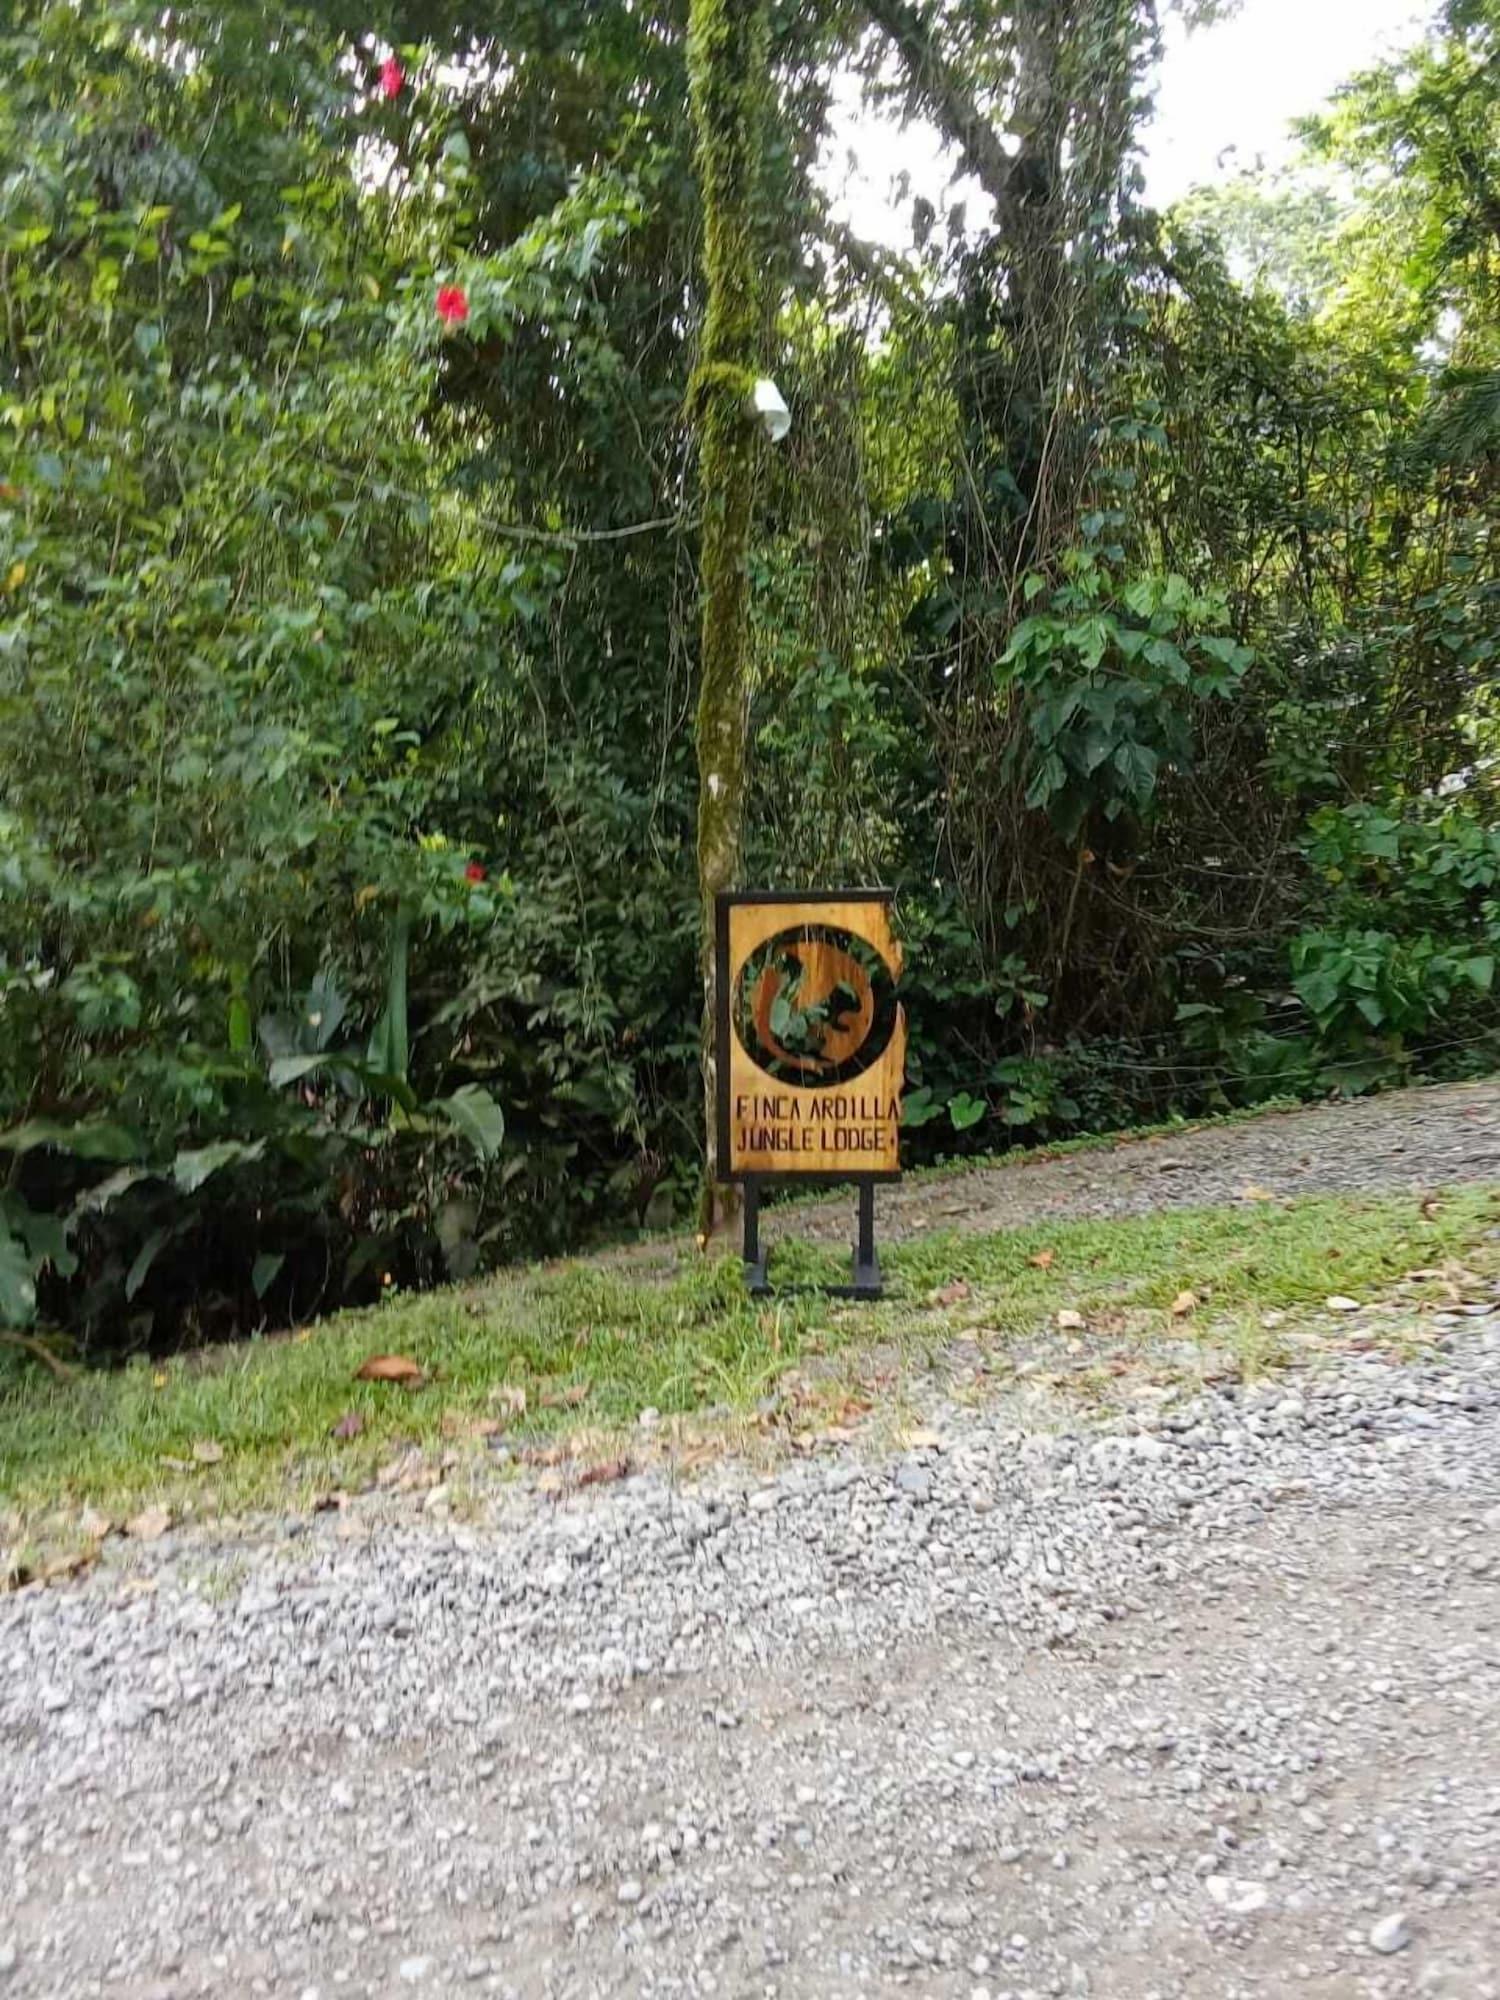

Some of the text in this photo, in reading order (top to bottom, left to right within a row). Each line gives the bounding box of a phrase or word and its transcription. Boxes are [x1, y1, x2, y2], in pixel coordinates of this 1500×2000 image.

[737, 1095, 899, 1120] FINCA ARDILLA
[737, 1127, 887, 1152] JUNGLE LODGE
